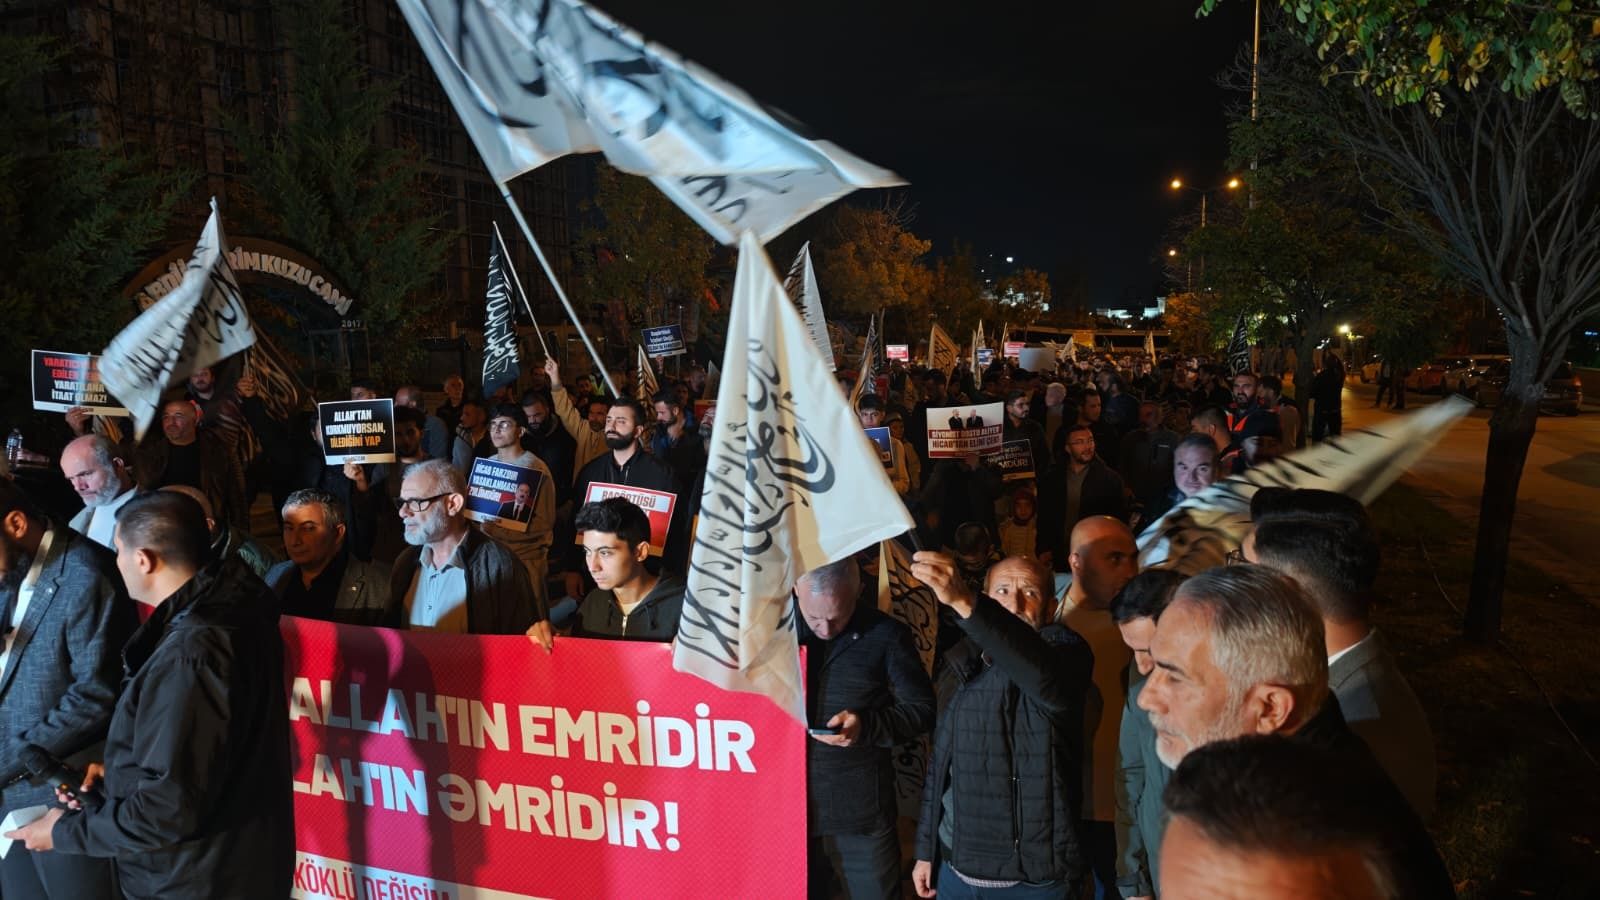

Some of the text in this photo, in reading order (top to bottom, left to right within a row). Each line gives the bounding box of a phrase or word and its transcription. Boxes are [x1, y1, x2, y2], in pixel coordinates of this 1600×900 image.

[261, 254, 312, 286] KUZU
[51, 388, 73, 401] İTAAT
[334, 409, 372, 422] ALLAH'TAN
[365, 435, 381, 447] YAP
[289, 677, 757, 774] ALLAH'IN EMRİDİR
[438, 775, 681, 852] ƏMRİDİR!
[294, 858, 451, 900] KÖKLÜ DEĞİ
